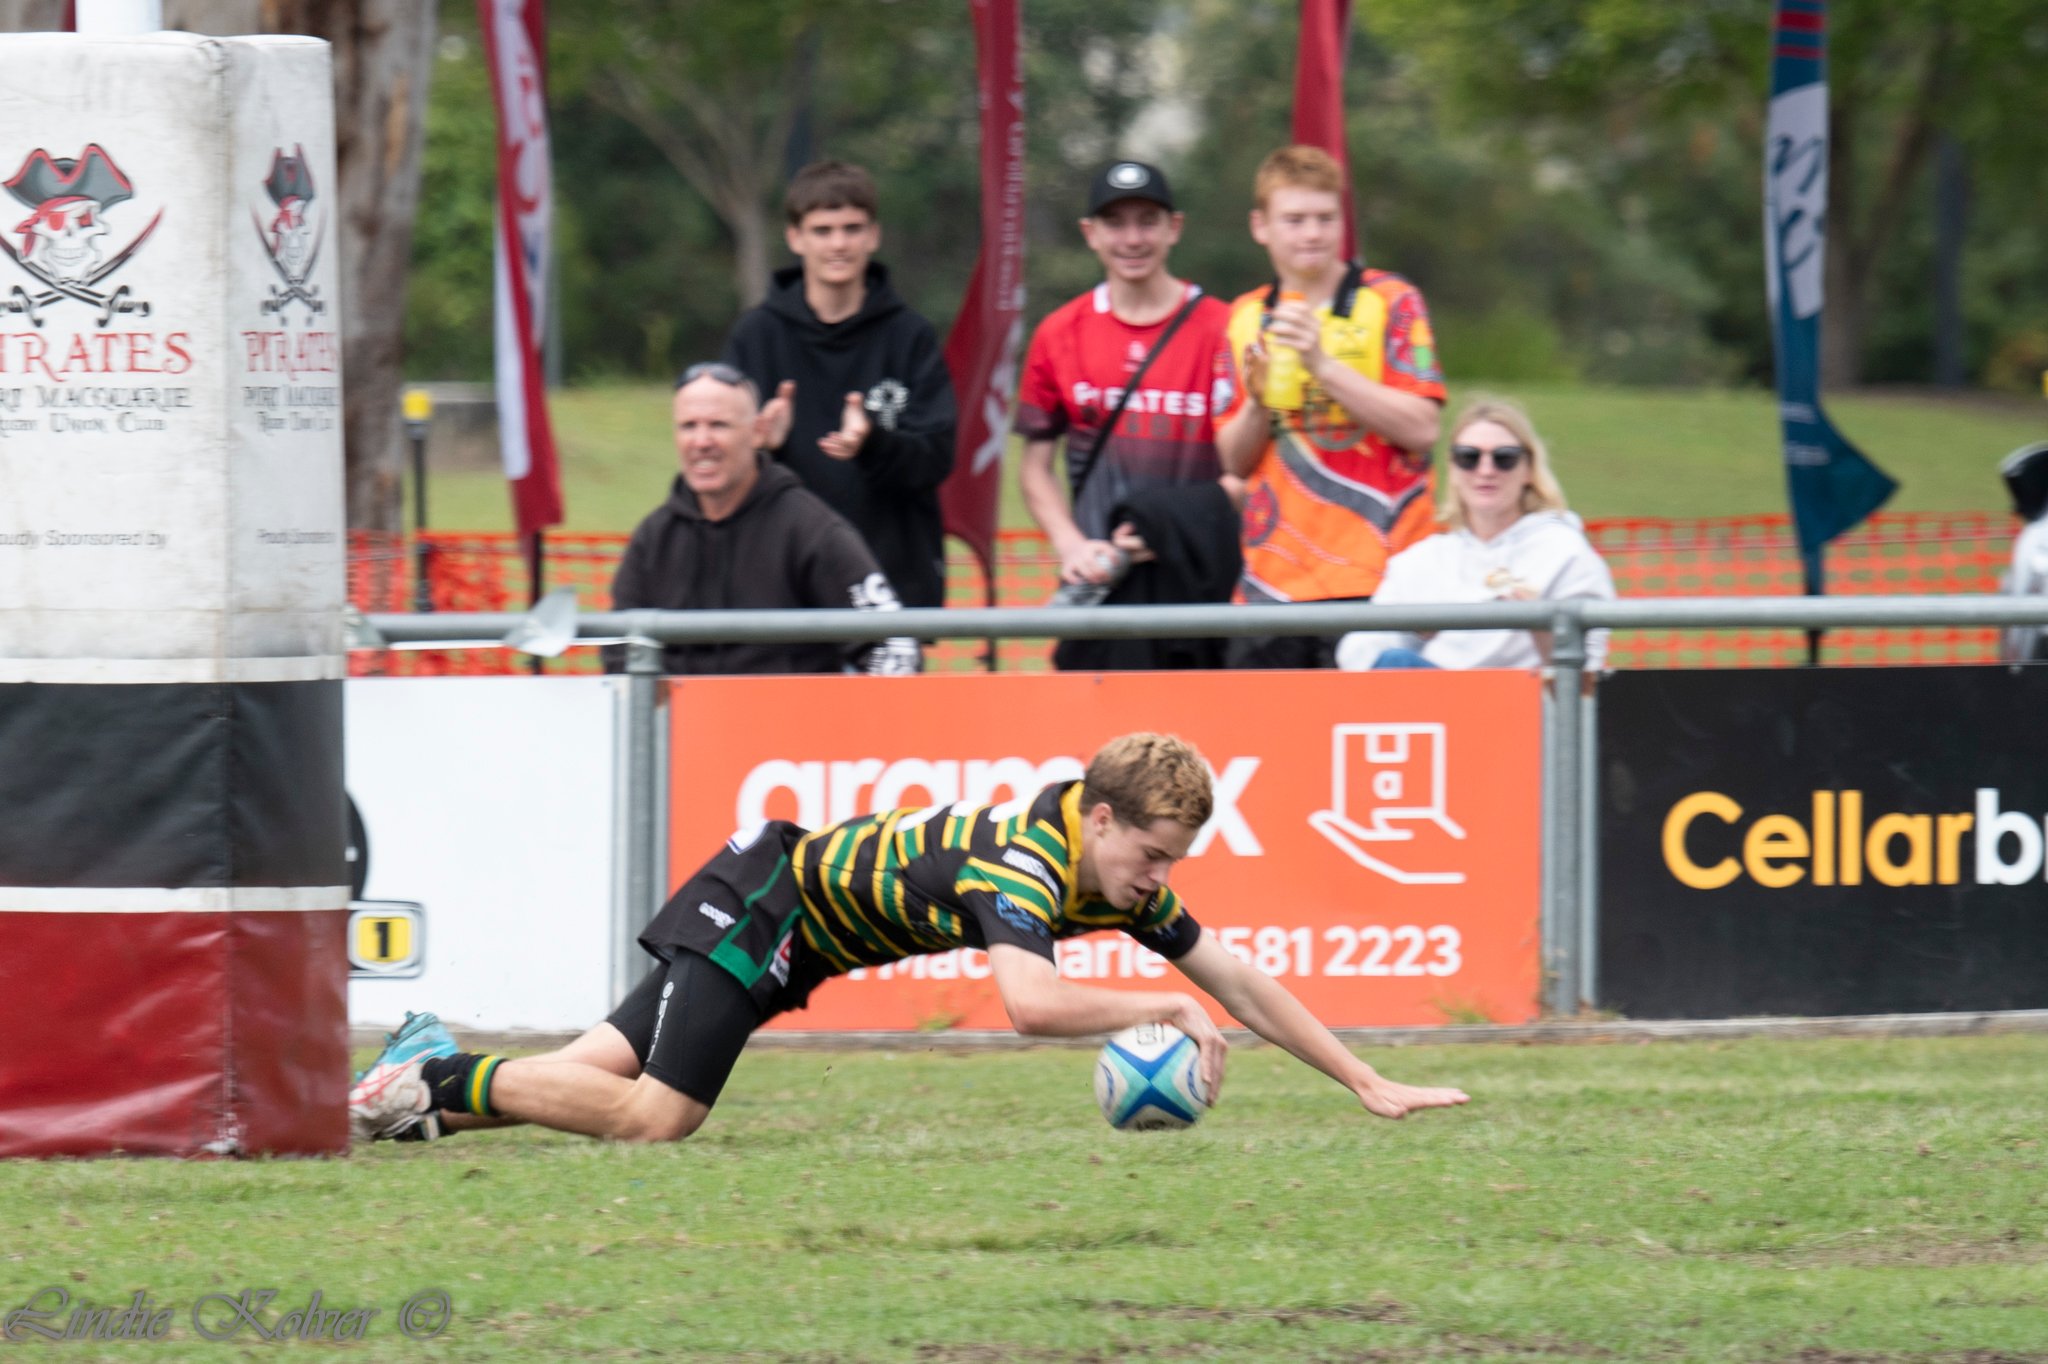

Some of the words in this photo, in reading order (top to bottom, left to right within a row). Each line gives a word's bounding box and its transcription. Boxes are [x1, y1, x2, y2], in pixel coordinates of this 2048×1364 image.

[736, 757, 1264, 857] arax
[1661, 788, 2048, 890] Cellarb
[876, 929, 1167, 980] acarie
[1201, 926, 1311, 977] 581
[1322, 925, 1462, 977] 2223
